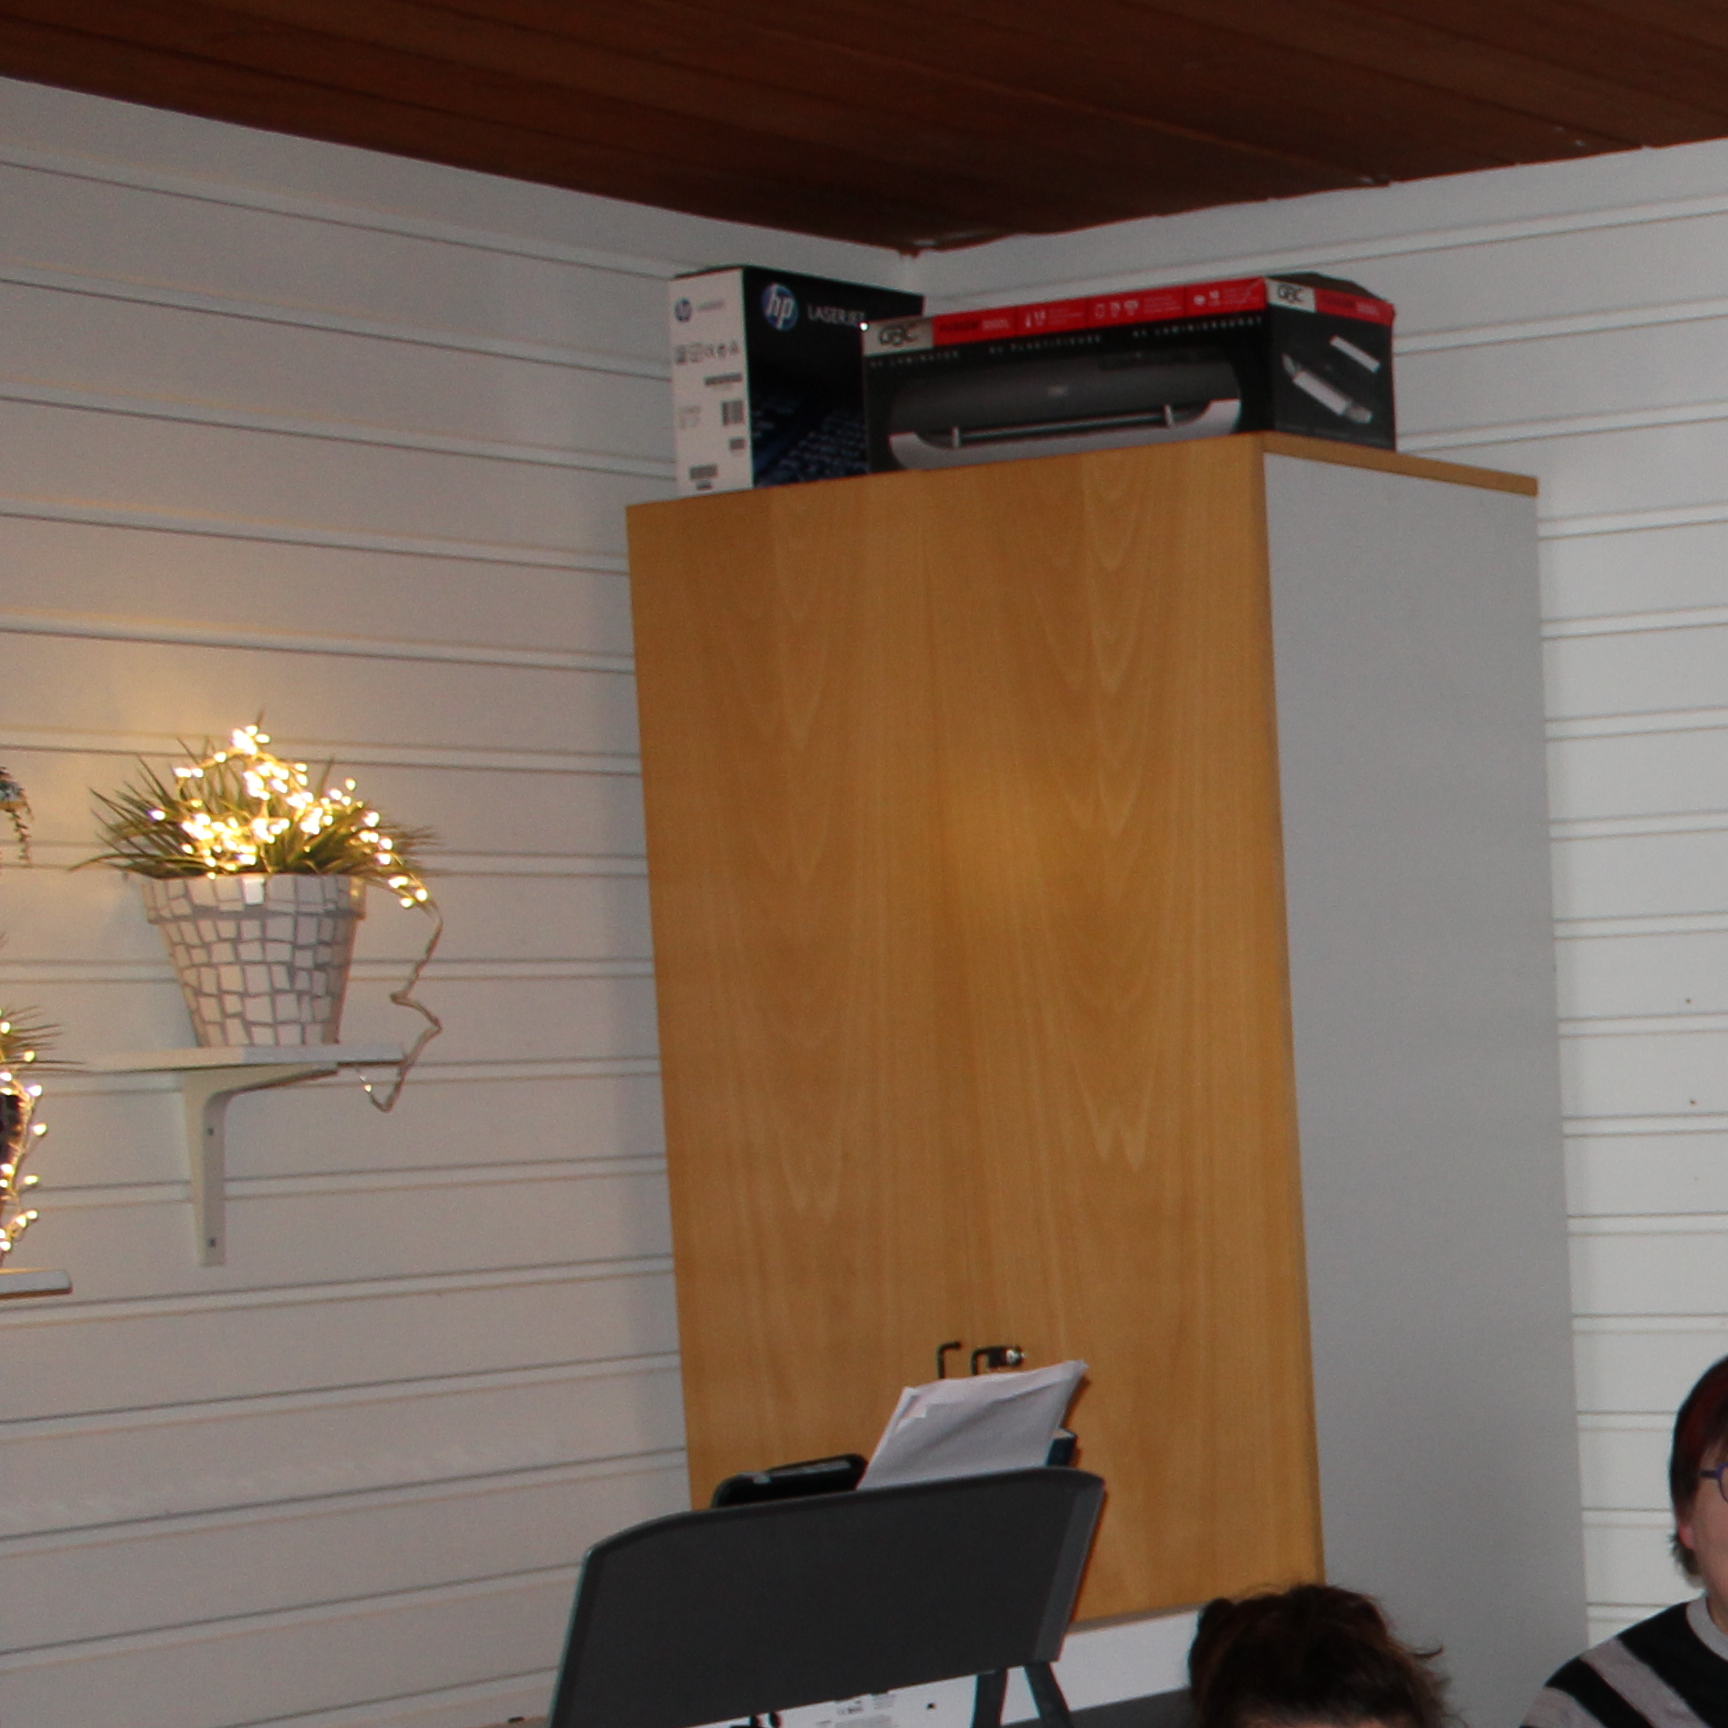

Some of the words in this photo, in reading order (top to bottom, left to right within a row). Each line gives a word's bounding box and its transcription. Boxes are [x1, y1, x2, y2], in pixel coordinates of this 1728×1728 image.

[763, 283, 797, 331] hp
[807, 302, 867, 327] LASERJET
[879, 323, 918, 346] GBC
